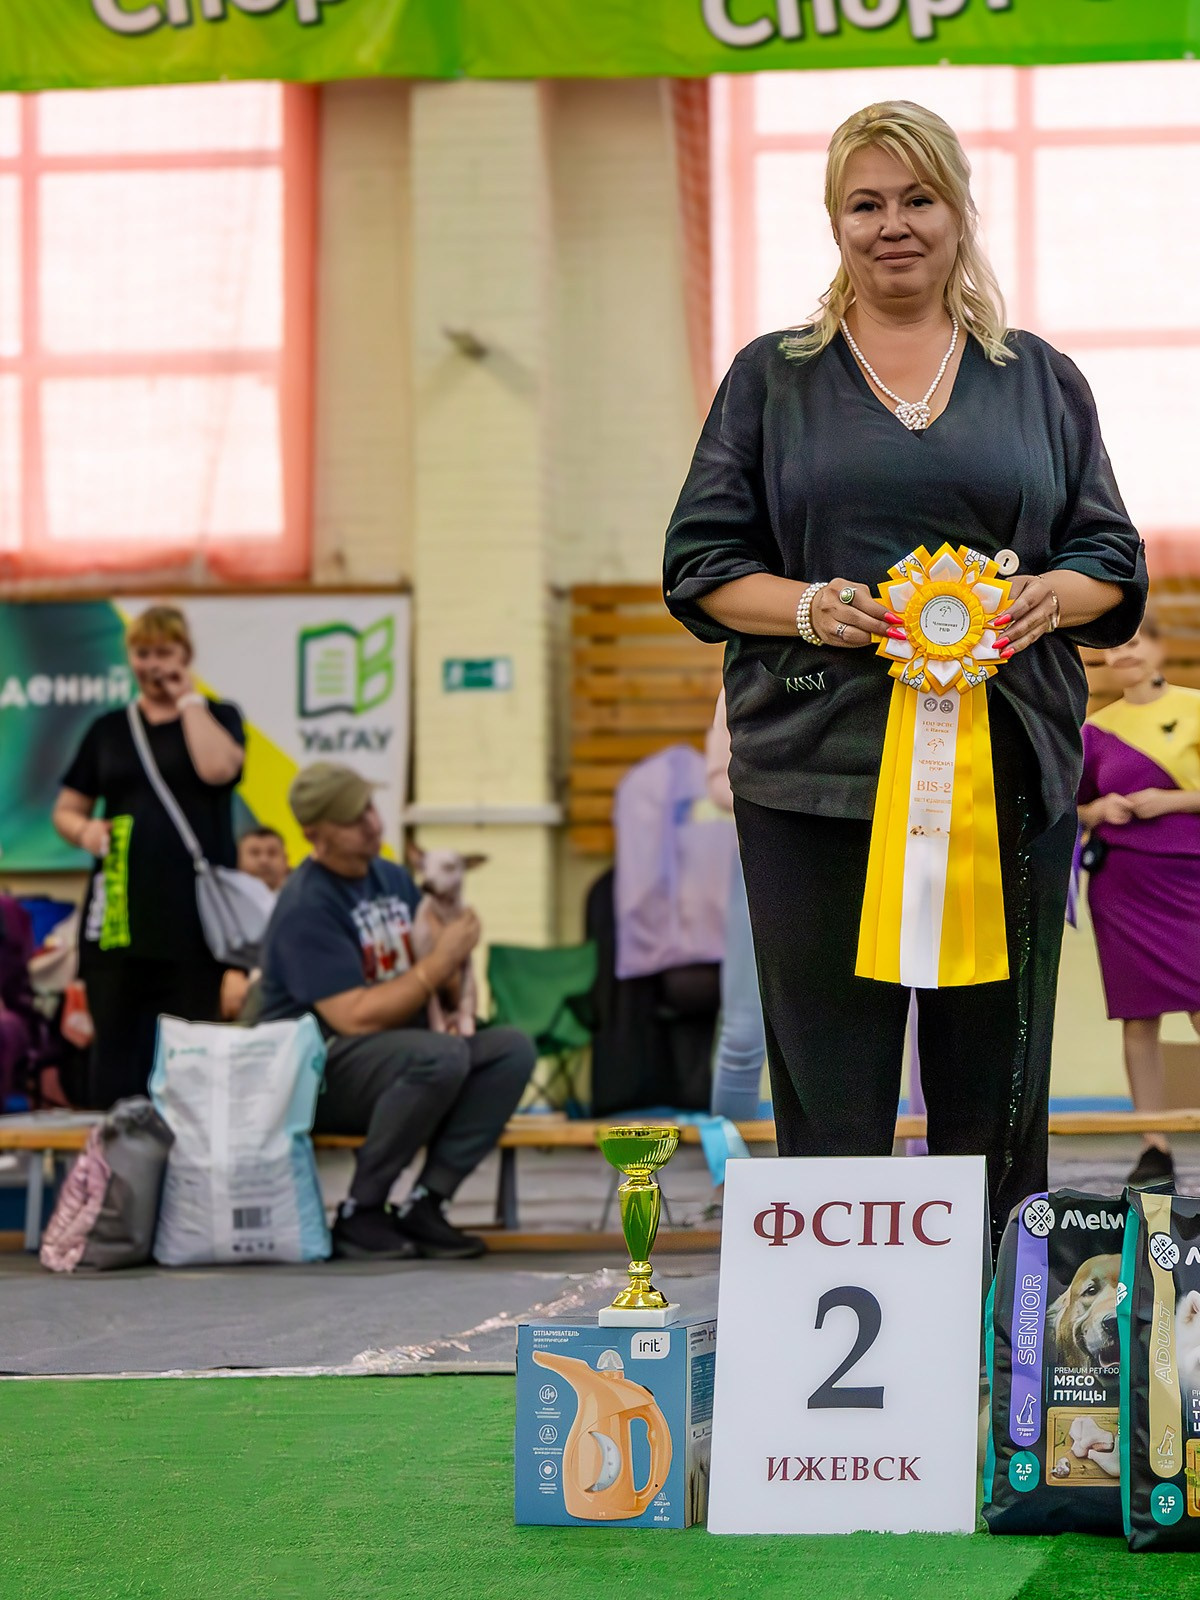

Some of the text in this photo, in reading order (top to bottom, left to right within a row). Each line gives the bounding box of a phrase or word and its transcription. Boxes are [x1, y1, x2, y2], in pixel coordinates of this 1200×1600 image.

[917, 780, 951, 793] BIS-2
[753, 1200, 952, 1246] ФСПС
[1017, 1274, 1042, 1365] SENIOR
[639, 1338, 664, 1353] irit
[807, 1285, 884, 1409] 2
[1154, 1300, 1174, 1385] ADULT
[1054, 1366, 1088, 1374] PREMIUM
[1054, 1375, 1095, 1387] МЯСО
[1053, 1389, 1107, 1403] ПТИЦЫ
[766, 1456, 921, 1481] ИЖЕВСК
[1016, 1463, 1033, 1475] 2,5
[1158, 1495, 1176, 1508] 2,5
